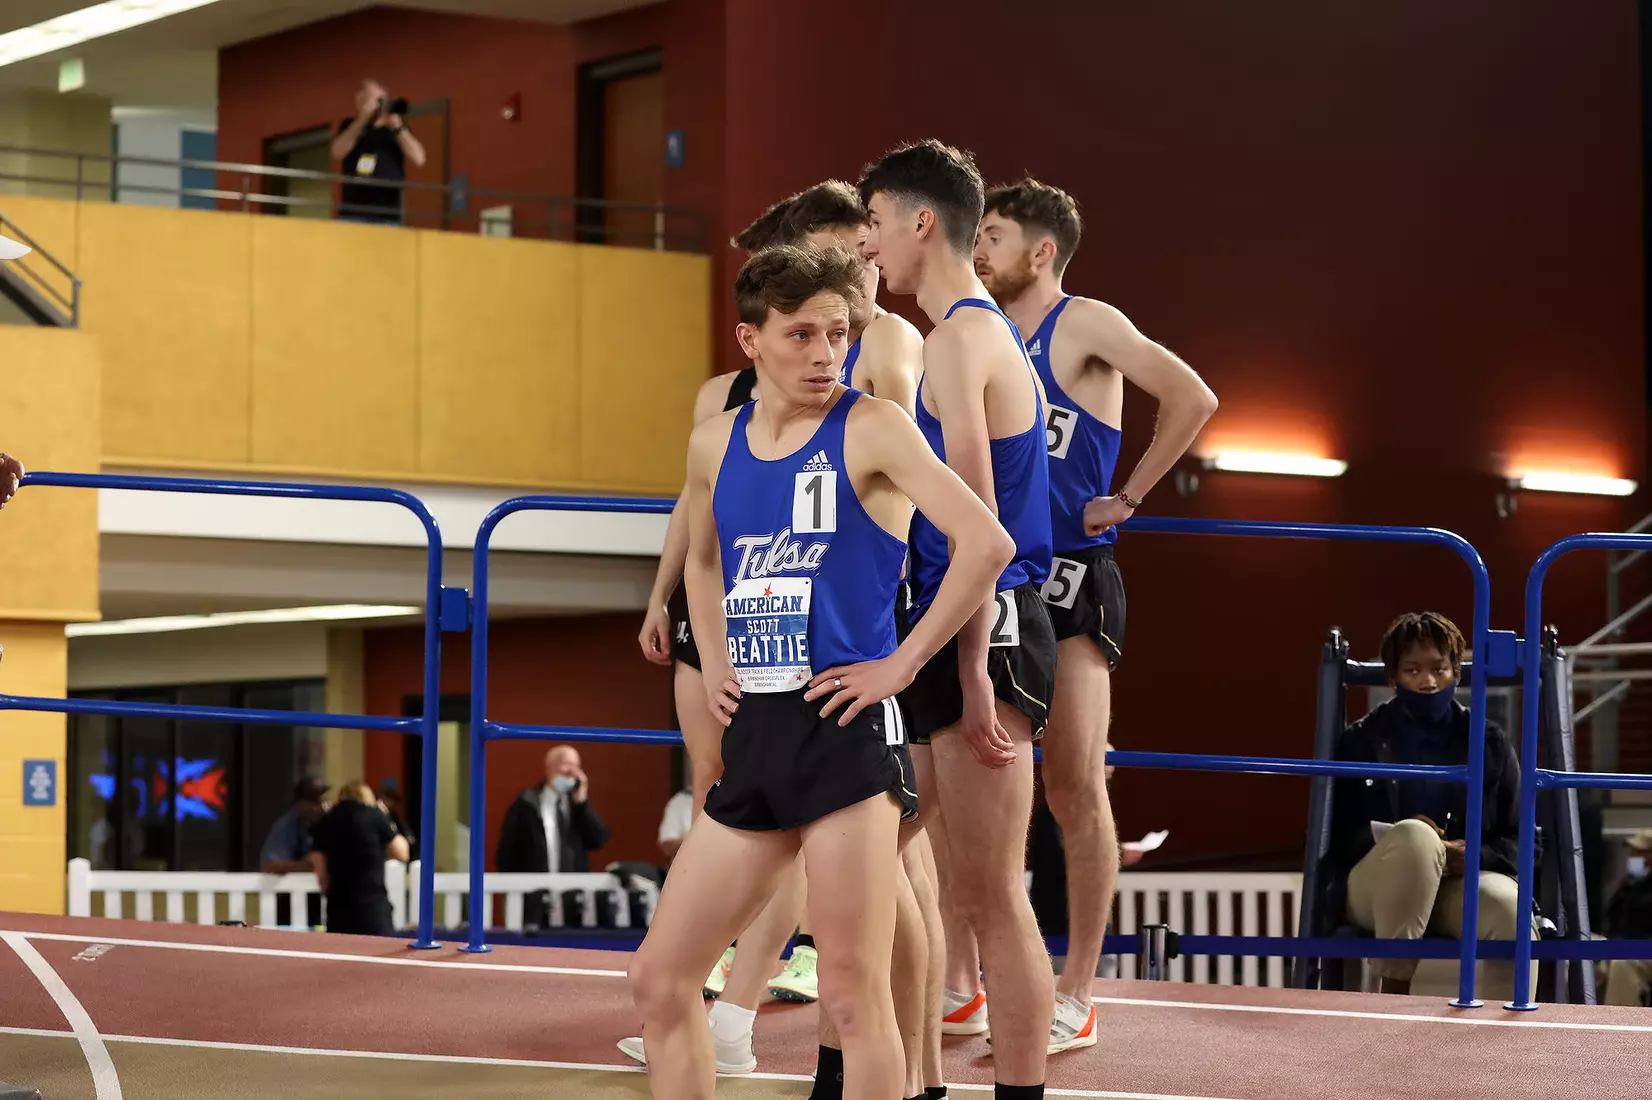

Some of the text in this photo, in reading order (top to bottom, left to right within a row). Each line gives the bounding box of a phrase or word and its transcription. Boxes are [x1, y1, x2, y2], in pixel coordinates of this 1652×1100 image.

[1046, 408, 1070, 452] 5
[803, 462, 833, 471] adidas
[805, 475, 823, 529] 1
[732, 526, 830, 584] Tulsa
[1047, 561, 1078, 602] 5
[726, 596, 803, 615] AMERICAN
[990, 593, 1012, 643] 2
[746, 619, 780, 634] SCOTT
[728, 636, 809, 663] BEATTIE
